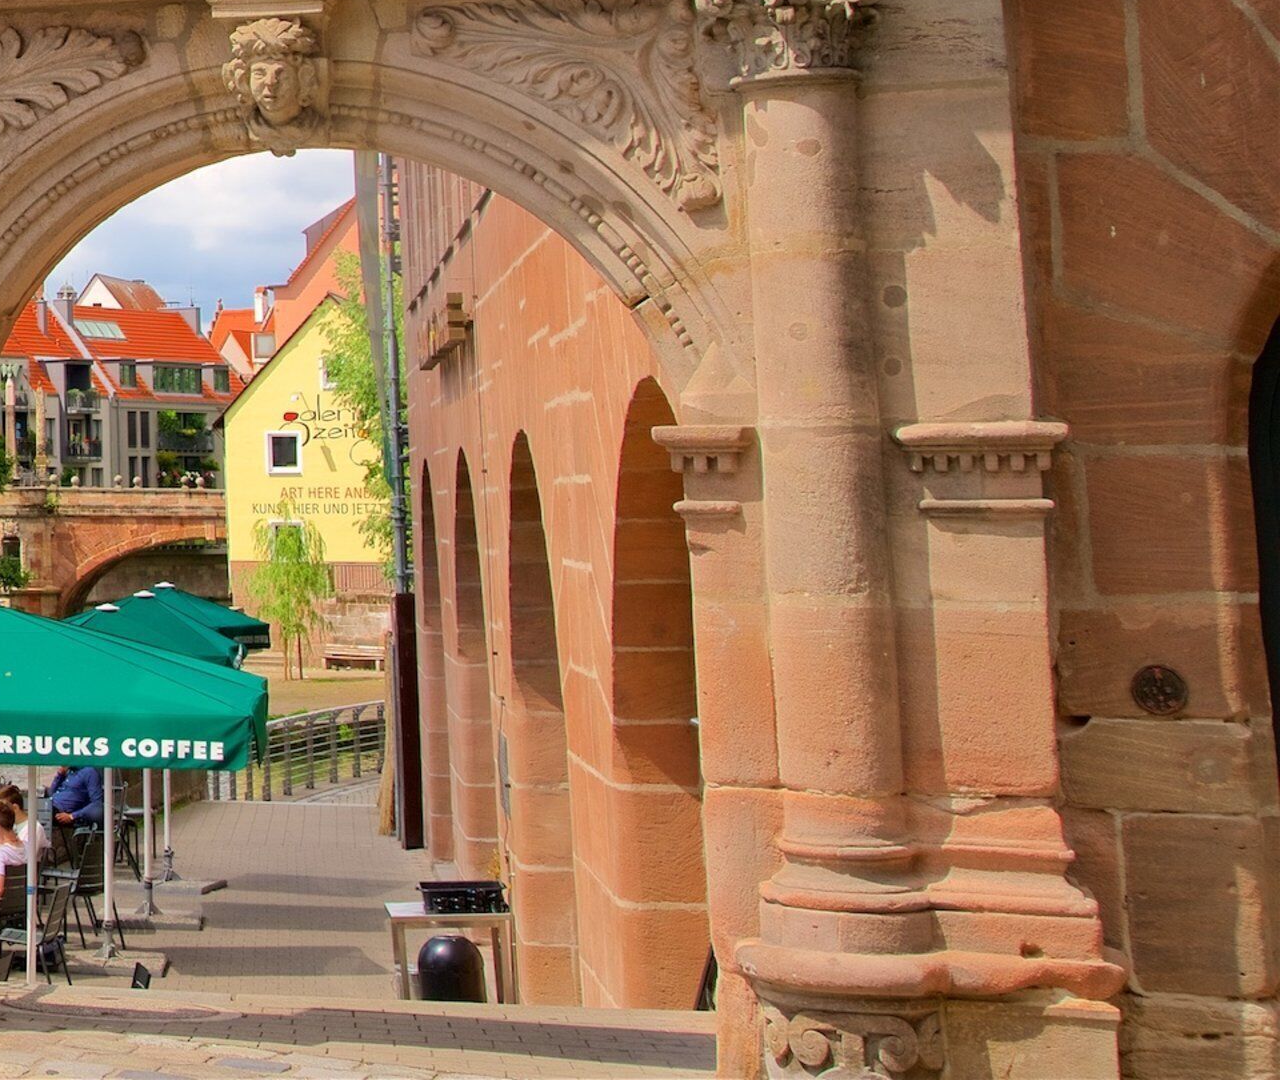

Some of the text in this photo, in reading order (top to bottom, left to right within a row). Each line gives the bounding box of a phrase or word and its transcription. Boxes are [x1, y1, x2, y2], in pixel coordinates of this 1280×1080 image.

[280, 487, 303, 499] ART
[308, 487, 340, 499] HERE
[252, 503, 288, 515] KUNS
[293, 503, 320, 515] HIER
[323, 503, 349, 515] UND
[121, 738, 224, 761] COFFEE
